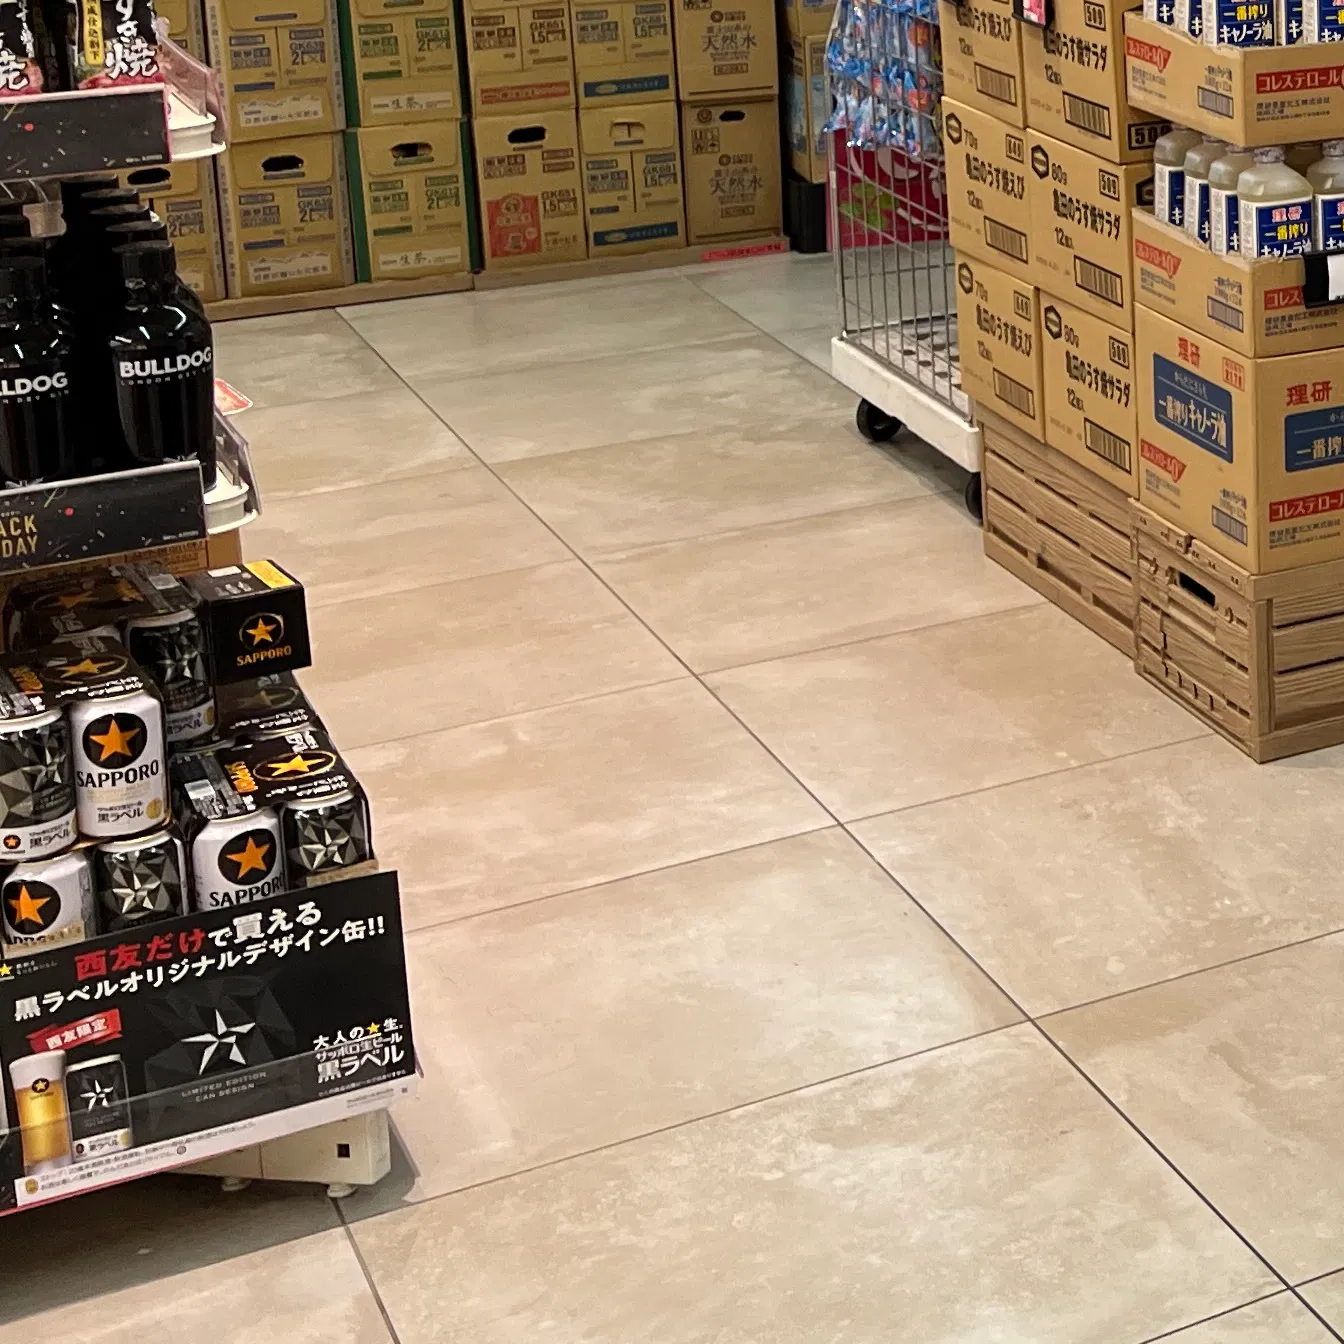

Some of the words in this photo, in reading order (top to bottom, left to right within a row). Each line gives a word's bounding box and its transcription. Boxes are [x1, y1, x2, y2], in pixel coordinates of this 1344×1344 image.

[1223, 4, 1268, 21] 一番搾り
[700, 29, 758, 52] 天然水
[119, 346, 212, 378] BULLDOG
[121, 376, 171, 386] LONDON
[1286, 380, 1333, 406] 理研
[236, 645, 292, 666] SAPPORO
[76, 759, 159, 788] SAPPORO
[97, 808, 144, 824] 黒ラベル
[29, 830, 70, 849] 黒ラベル
[74, 901, 322, 981] 西友だけで買える
[14, 916, 386, 1022] 黒ラベルオリジナルデザイン缶!!
[46, 1017, 108, 1050] 西友限定
[313, 1024, 365, 1052] 大人の
[315, 1033, 403, 1062] サッポロ生ビール
[317, 1045, 405, 1084] 黒ラベル
[182, 1082, 222, 1097] LIMITED
[226, 1071, 268, 1085] EDITION
[195, 1092, 216, 1103] CAN
[219, 1083, 256, 1097] DESIGN
